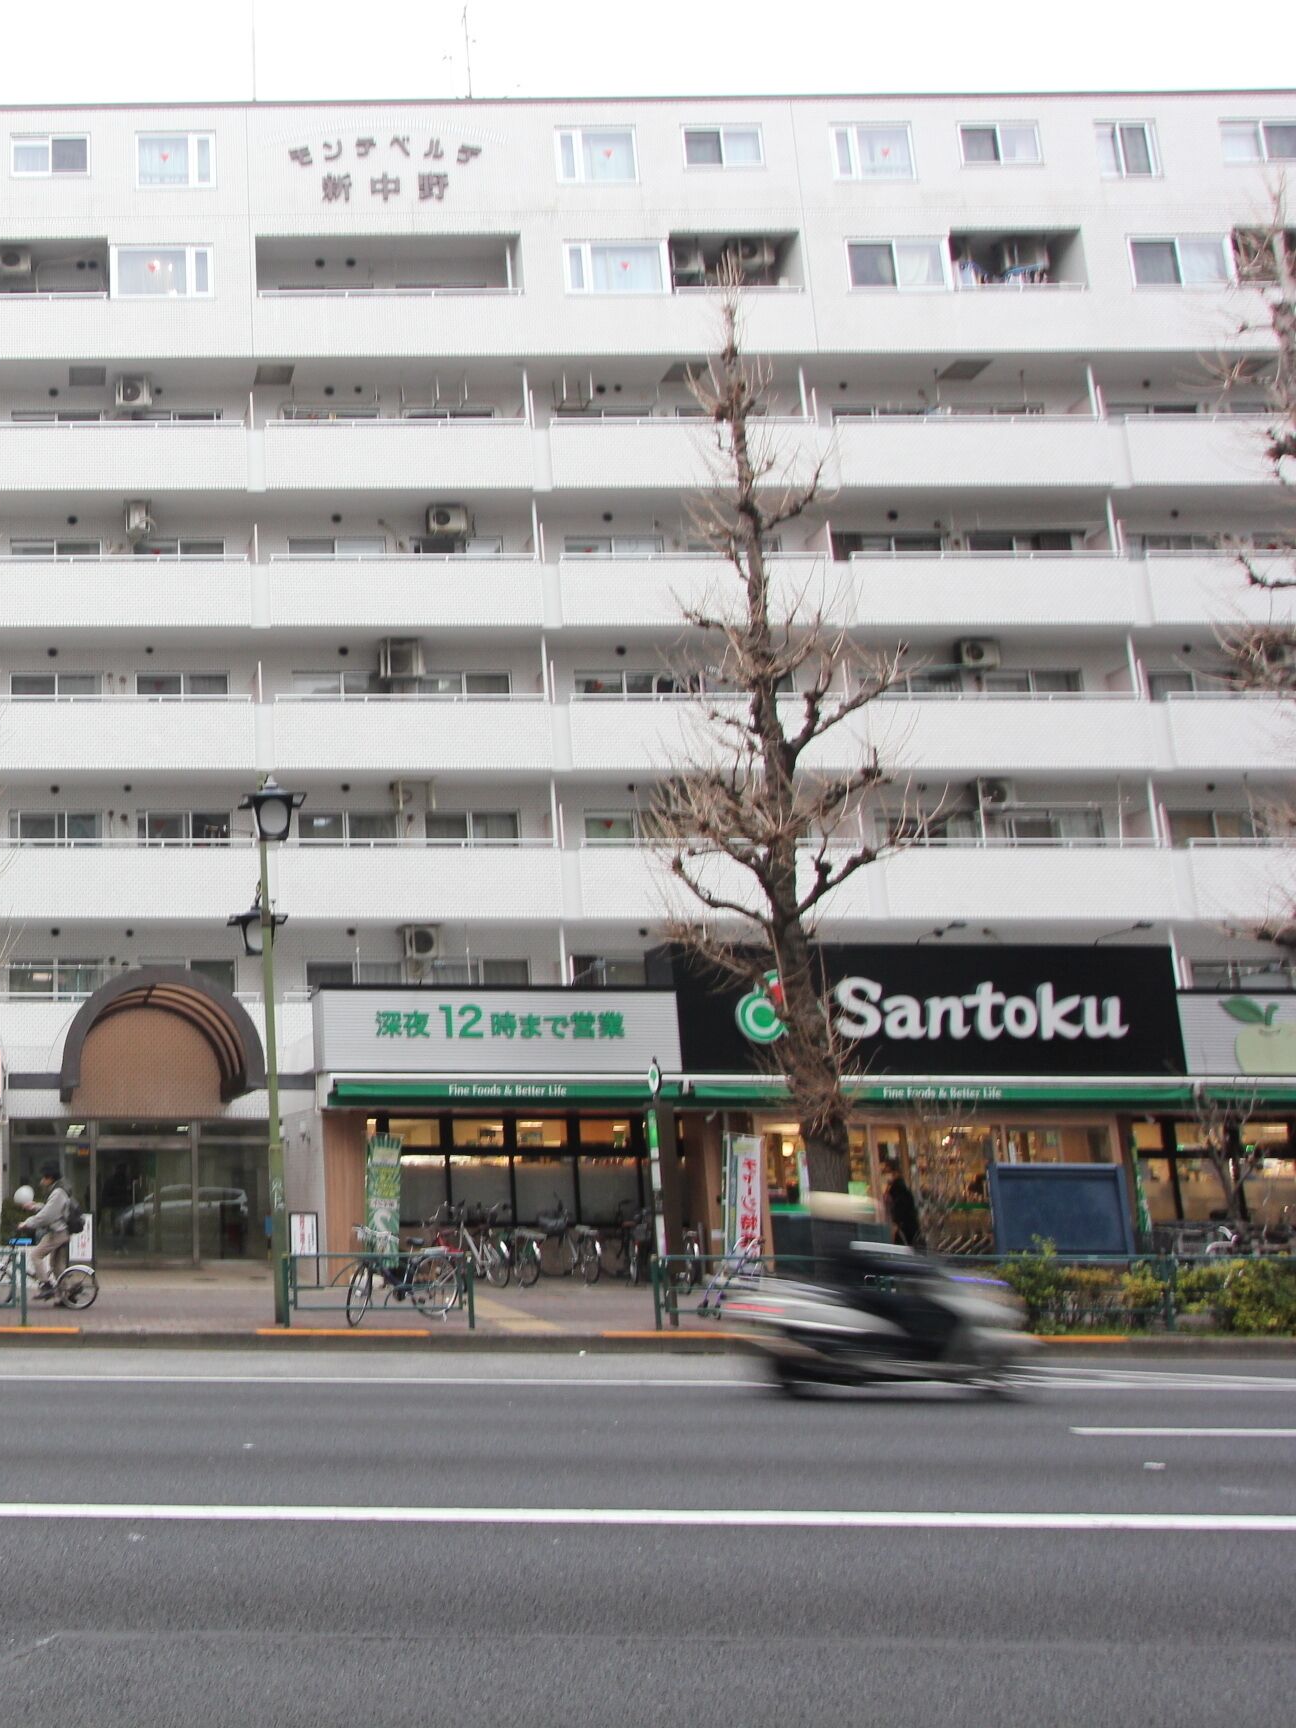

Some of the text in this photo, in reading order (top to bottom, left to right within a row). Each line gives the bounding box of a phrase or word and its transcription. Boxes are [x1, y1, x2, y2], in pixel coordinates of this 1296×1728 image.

[322, 171, 448, 203] 新中野
[834, 975, 1129, 1040] Santoku
[448, 1084, 567, 1098] Fine Foods & Better Life
[883, 1086, 1002, 1100] Fine Foods & Better Life
